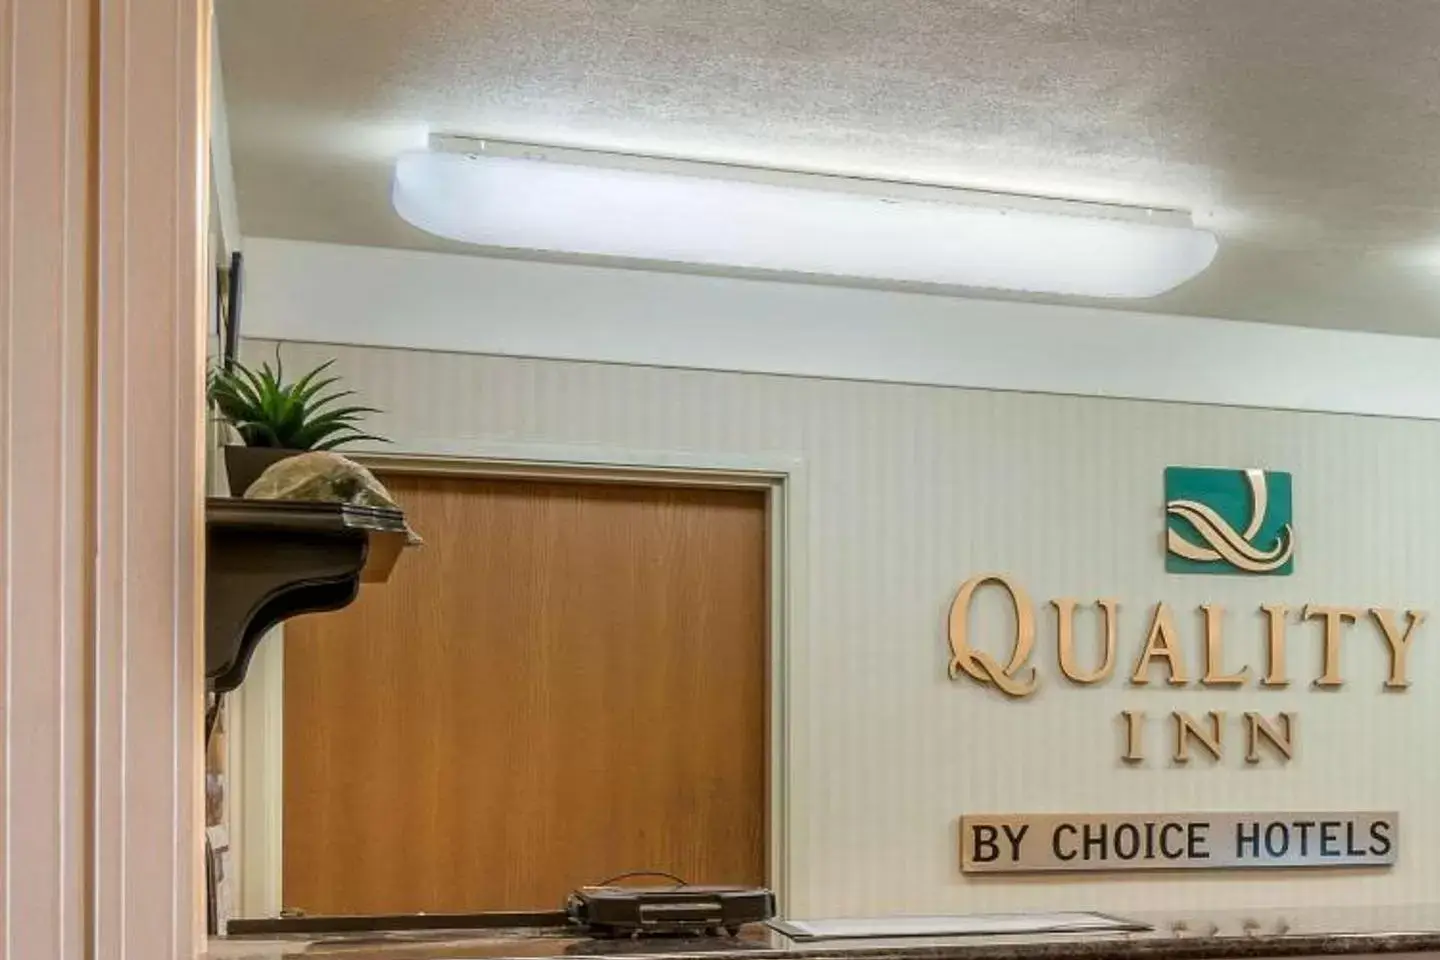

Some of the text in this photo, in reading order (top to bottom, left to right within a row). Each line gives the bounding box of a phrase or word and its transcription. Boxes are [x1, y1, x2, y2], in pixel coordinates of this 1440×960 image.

[947, 575, 1427, 696] QUALITY
[1121, 710, 1297, 764] INN
[970, 820, 1392, 864] BY CHOICE HOTELS
